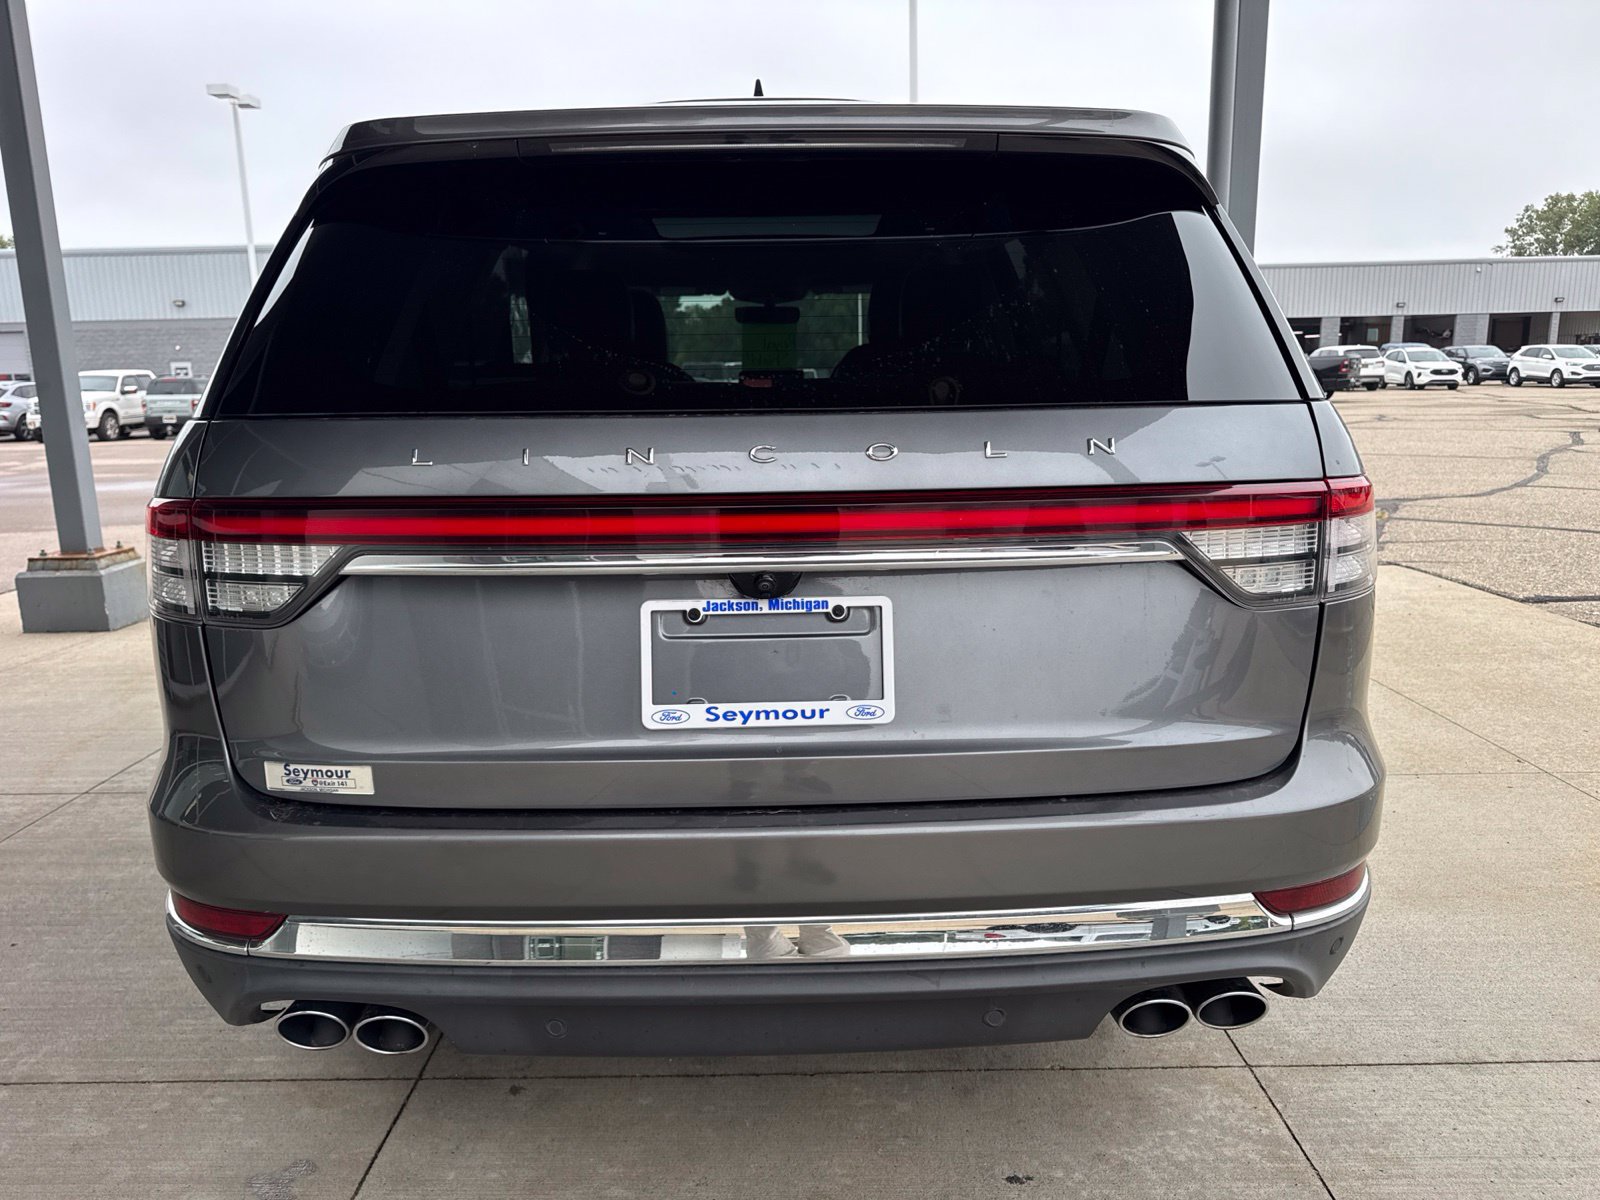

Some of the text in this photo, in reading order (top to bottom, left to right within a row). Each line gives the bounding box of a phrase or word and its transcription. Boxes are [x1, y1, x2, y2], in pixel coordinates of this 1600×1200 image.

[410, 437, 1117, 467] LINCOLN
[702, 598, 829, 612] Jackson, Michigan
[705, 706, 830, 725] Seymour
[283, 763, 351, 780] Seymour
